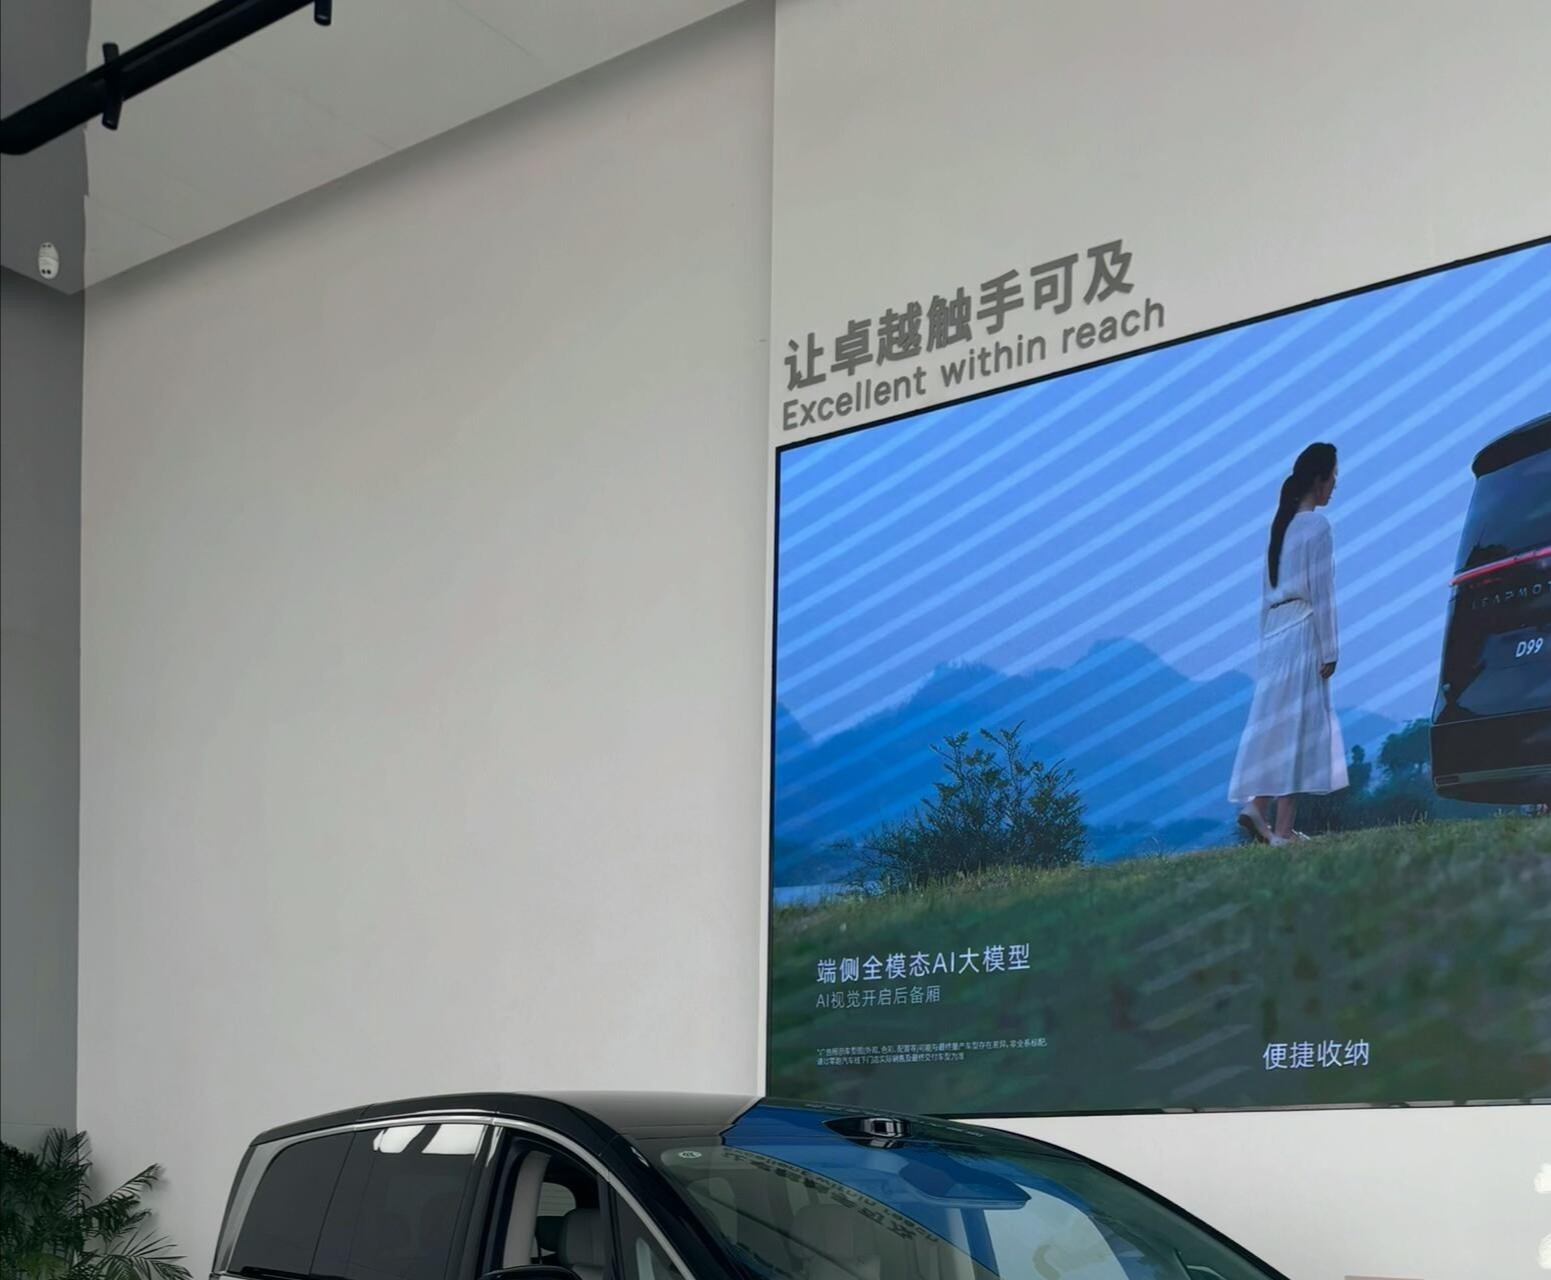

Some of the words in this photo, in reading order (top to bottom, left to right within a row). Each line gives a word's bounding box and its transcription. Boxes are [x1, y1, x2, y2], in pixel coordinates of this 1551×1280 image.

[784, 239, 1135, 391] 让卓越触手可及
[783, 366, 926, 431] Excellent
[941, 334, 1046, 387] within
[1062, 298, 1164, 353] reach
[1472, 580, 1551, 610] LEAPMO
[1515, 637, 1544, 658] D99
[816, 943, 1031, 984] 端侧全模态AI大模型
[816, 985, 941, 1009] AI视觉开启后备厢
[1263, 1038, 1369, 1071] 便捷收纳
